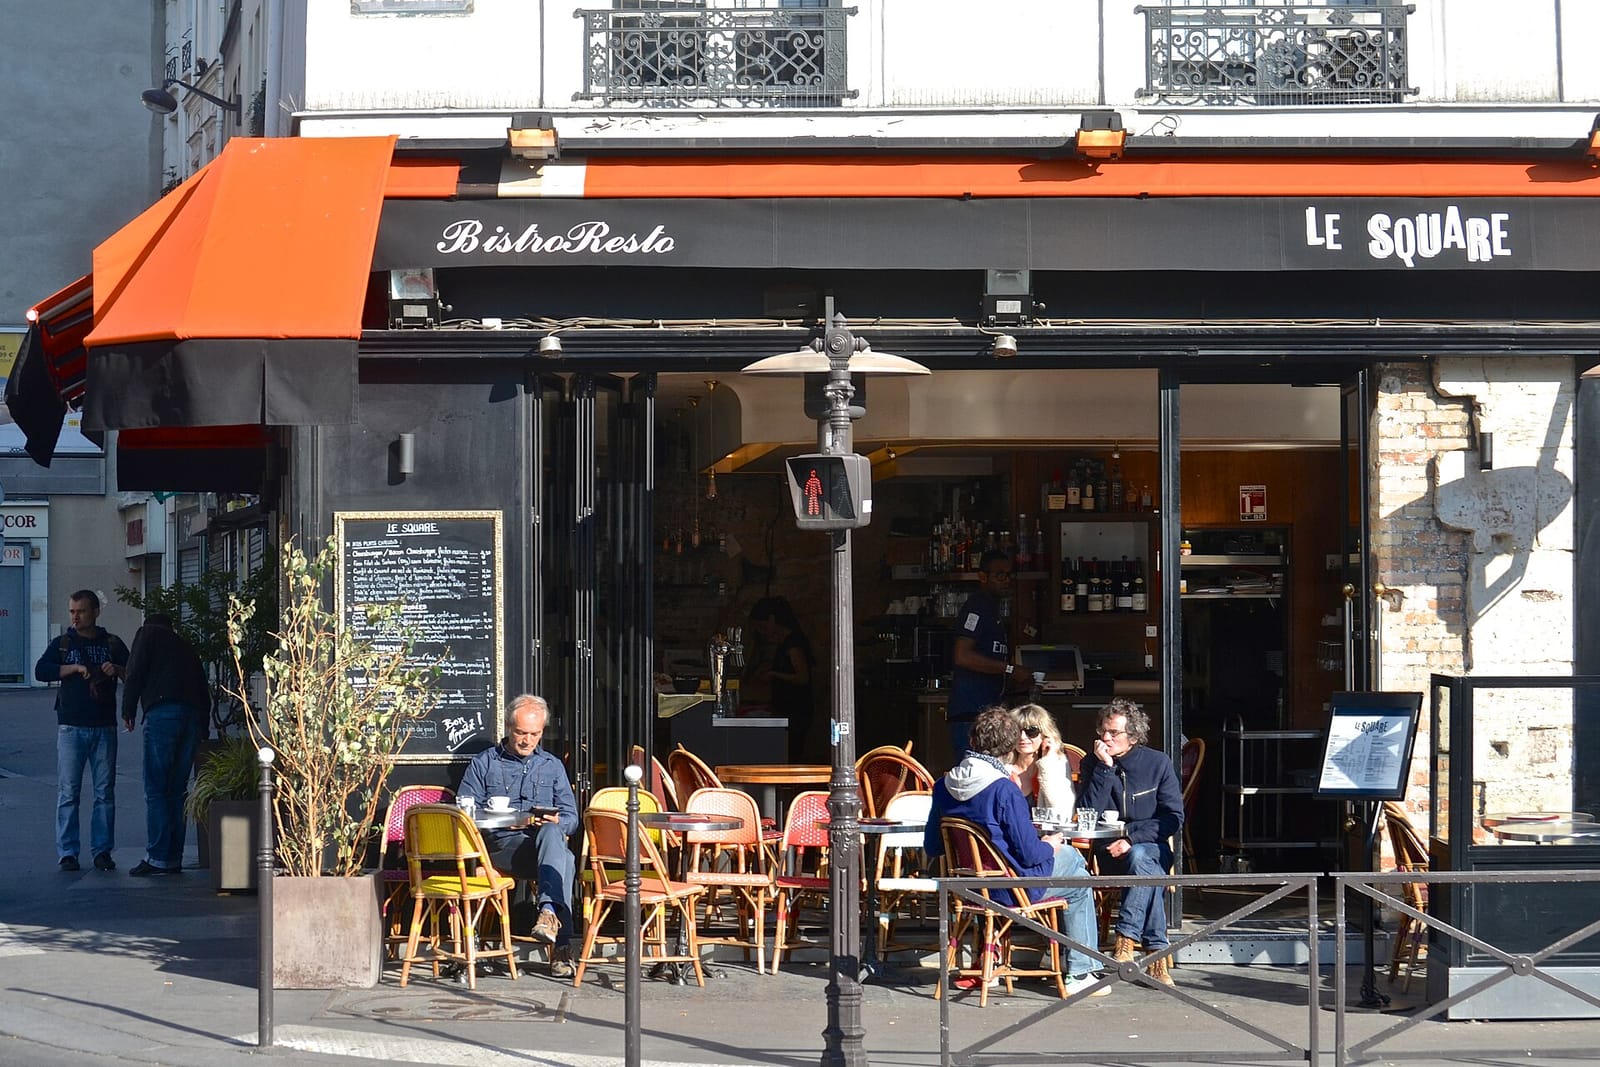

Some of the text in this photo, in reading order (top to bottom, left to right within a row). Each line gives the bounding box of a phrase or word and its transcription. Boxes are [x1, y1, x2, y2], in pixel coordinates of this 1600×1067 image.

[1305, 205, 1512, 268] LE SQUARE
[387, 523, 438, 533] LE SQUARE
[442, 715, 466, 732] Bon
[1360, 720, 1389, 735] SQUARE
